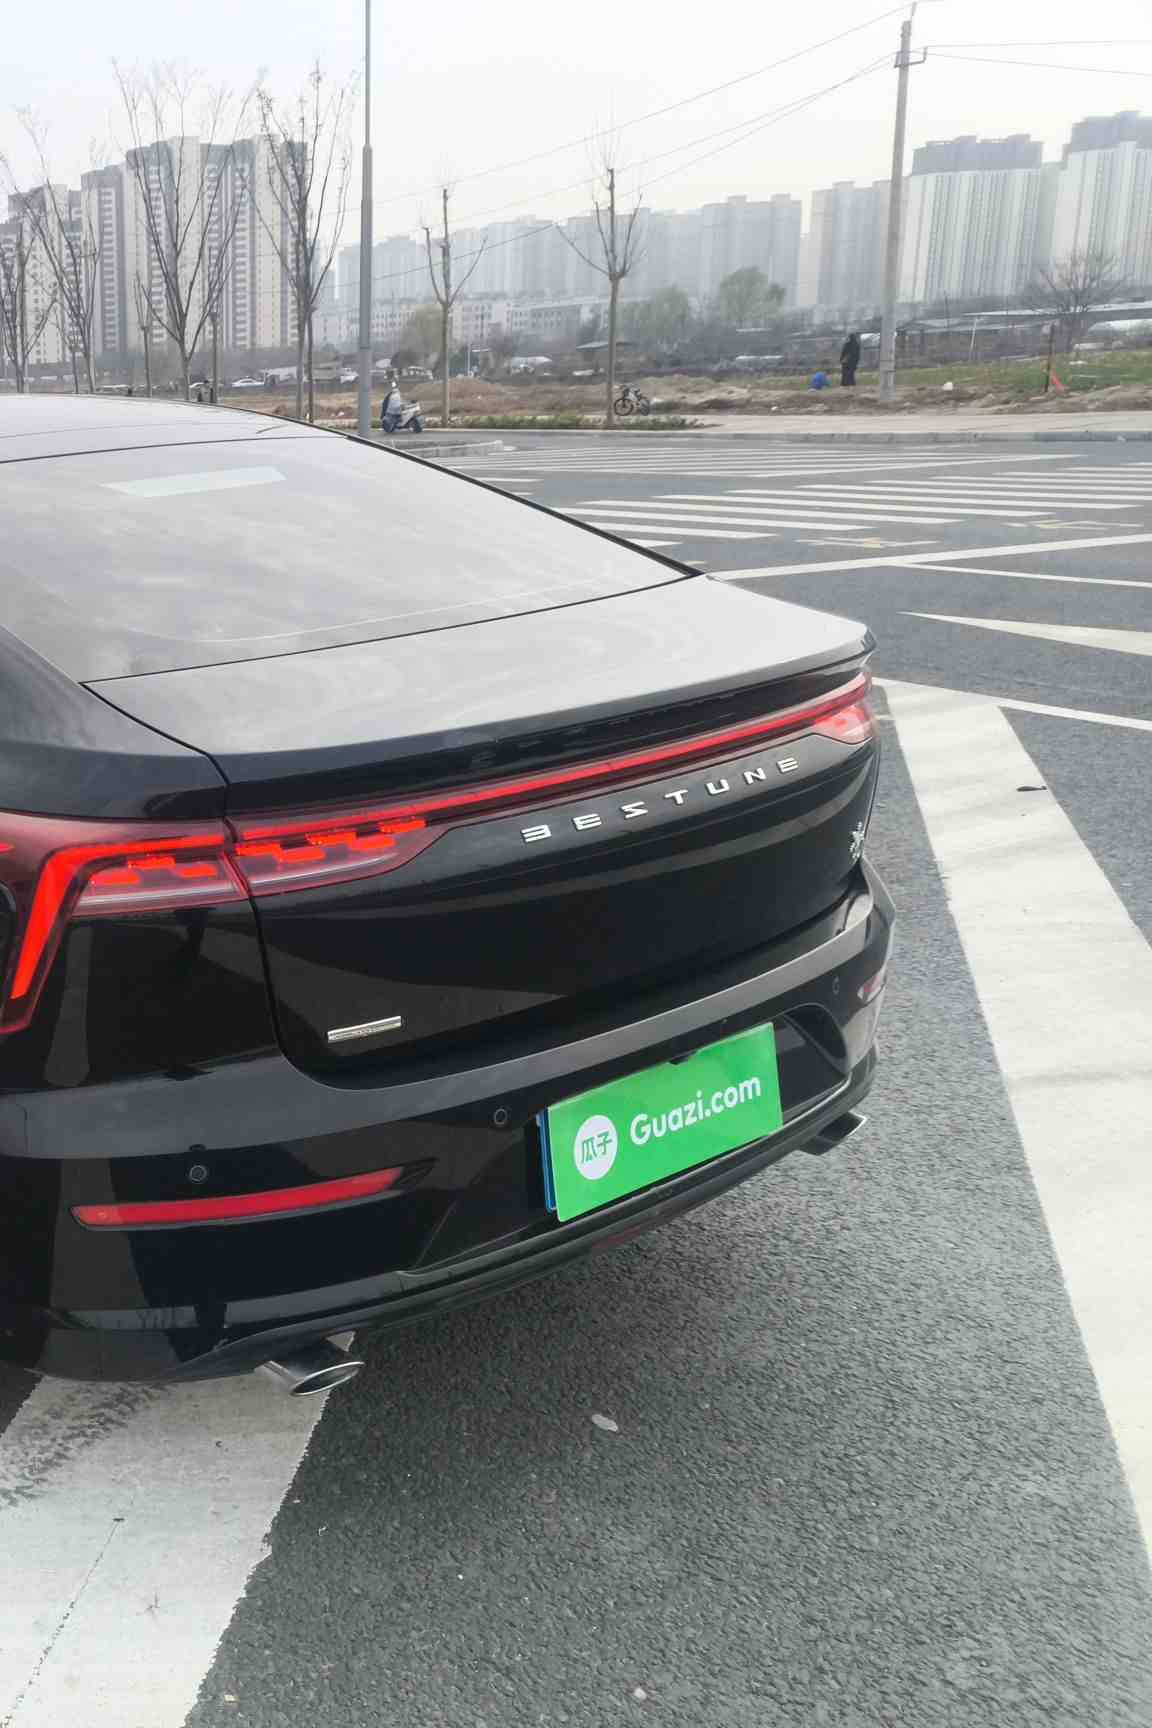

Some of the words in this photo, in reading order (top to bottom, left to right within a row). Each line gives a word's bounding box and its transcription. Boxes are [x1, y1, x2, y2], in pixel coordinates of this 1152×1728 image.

[521, 757, 800, 844] BESTUNE
[630, 1077, 762, 1145] Guazi.com
[580, 1129, 613, 1165] 瓜子
